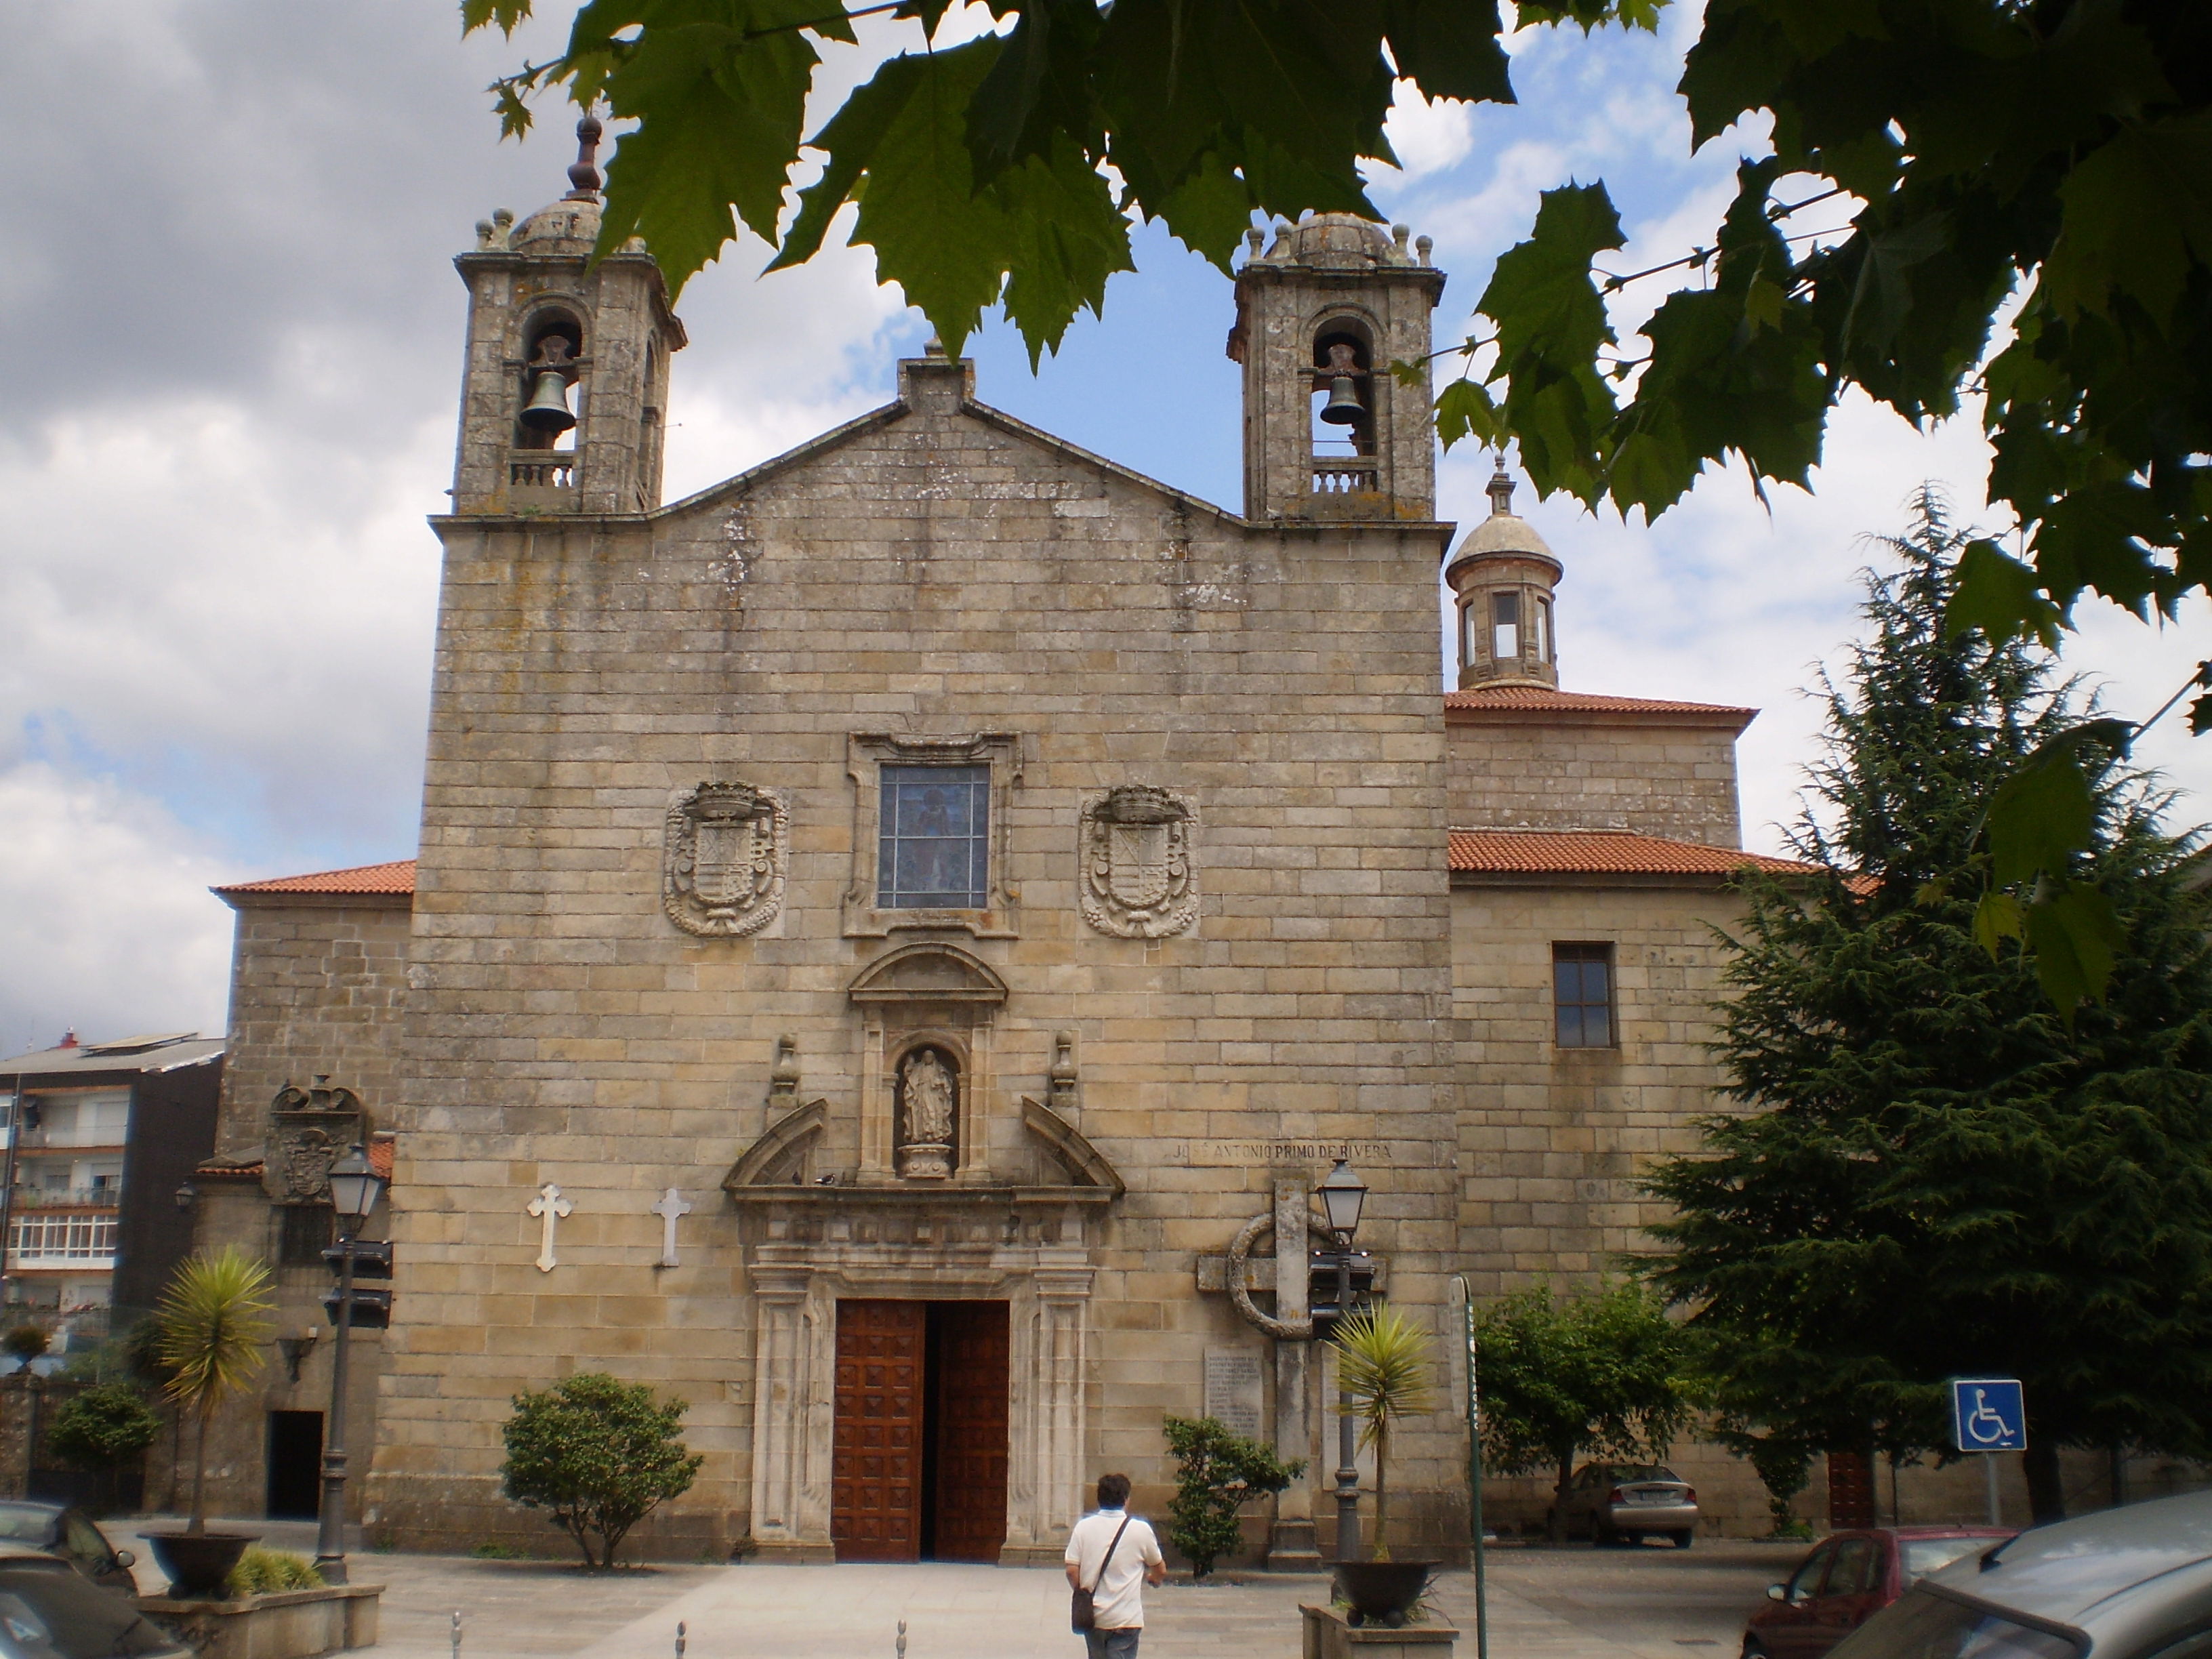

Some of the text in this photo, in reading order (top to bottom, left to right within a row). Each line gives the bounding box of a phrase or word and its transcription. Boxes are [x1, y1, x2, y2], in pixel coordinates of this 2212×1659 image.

[1214, 1145, 1271, 1158] ANTONIO
[1275, 1145, 1315, 1158] PRIMO
[1319, 1145, 1336, 1158] DE
[1340, 1145, 1392, 1158] RIVERA
